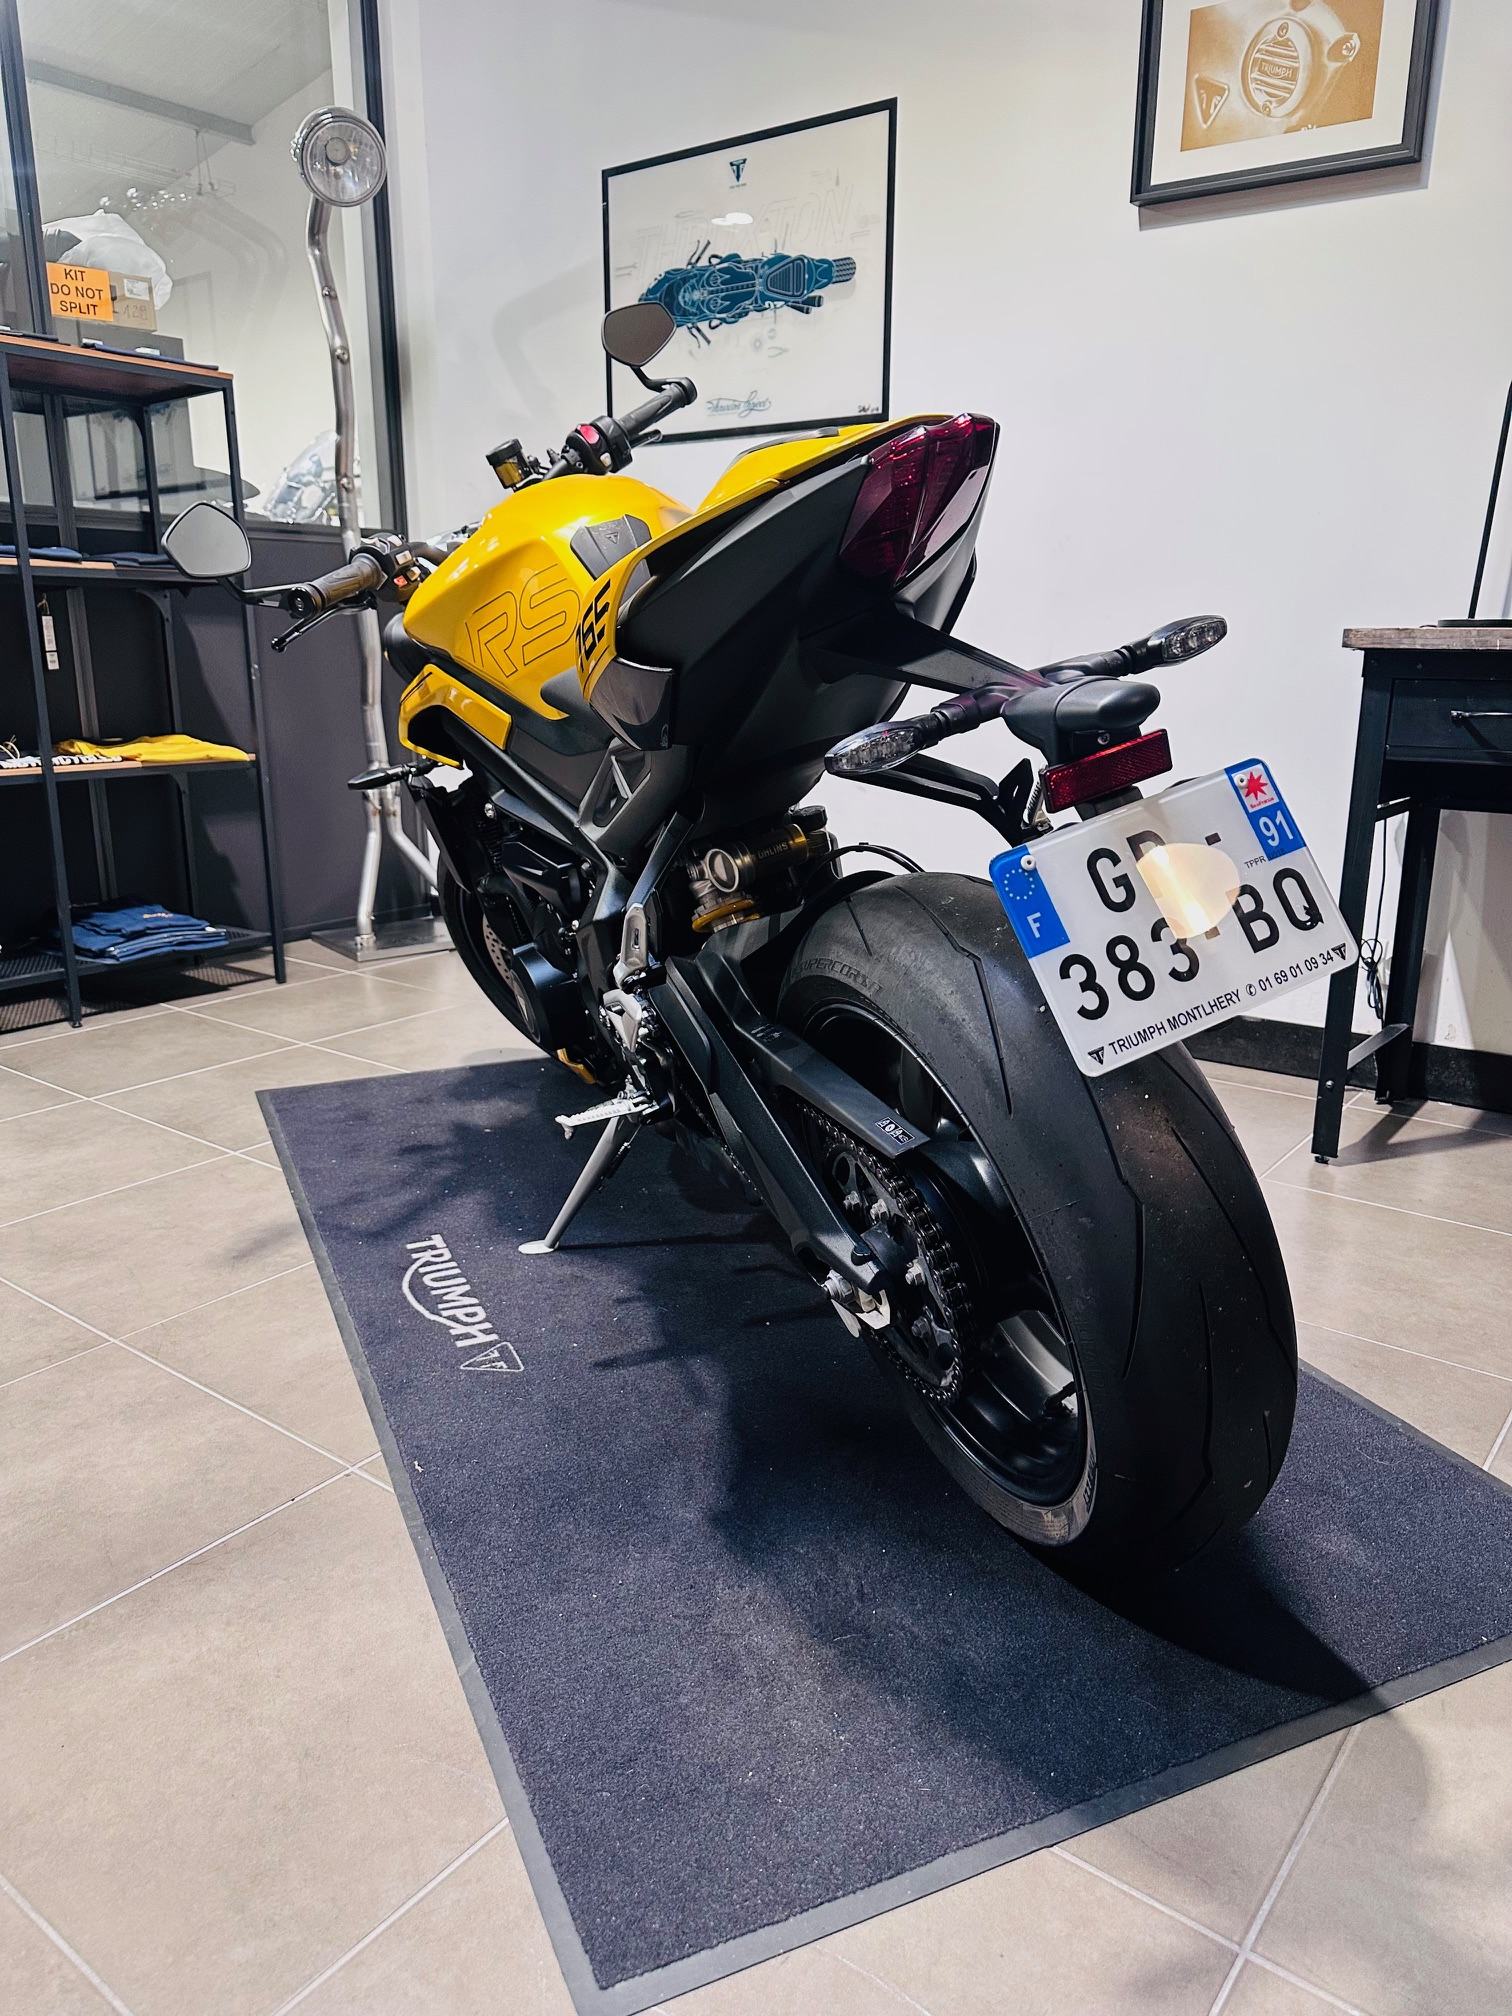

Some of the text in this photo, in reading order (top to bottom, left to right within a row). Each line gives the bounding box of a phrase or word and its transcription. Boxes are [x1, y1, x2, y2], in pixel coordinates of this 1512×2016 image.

[1261, 61, 1293, 78] TRIUMPH
[63, 267, 86, 282] KIT
[50, 282, 104, 301] DO NOT
[59, 300, 99, 316] SPLIT
[464, 563, 581, 678] RS
[1258, 809, 1294, 847] 91
[1243, 855, 1267, 869] TPPR
[1026, 912, 1041, 939] F
[1108, 949, 1334, 1056] TRIUMPH MONTLHERY 01 69 01 09 34
[402, 1233, 499, 1348] TRIUMPH
